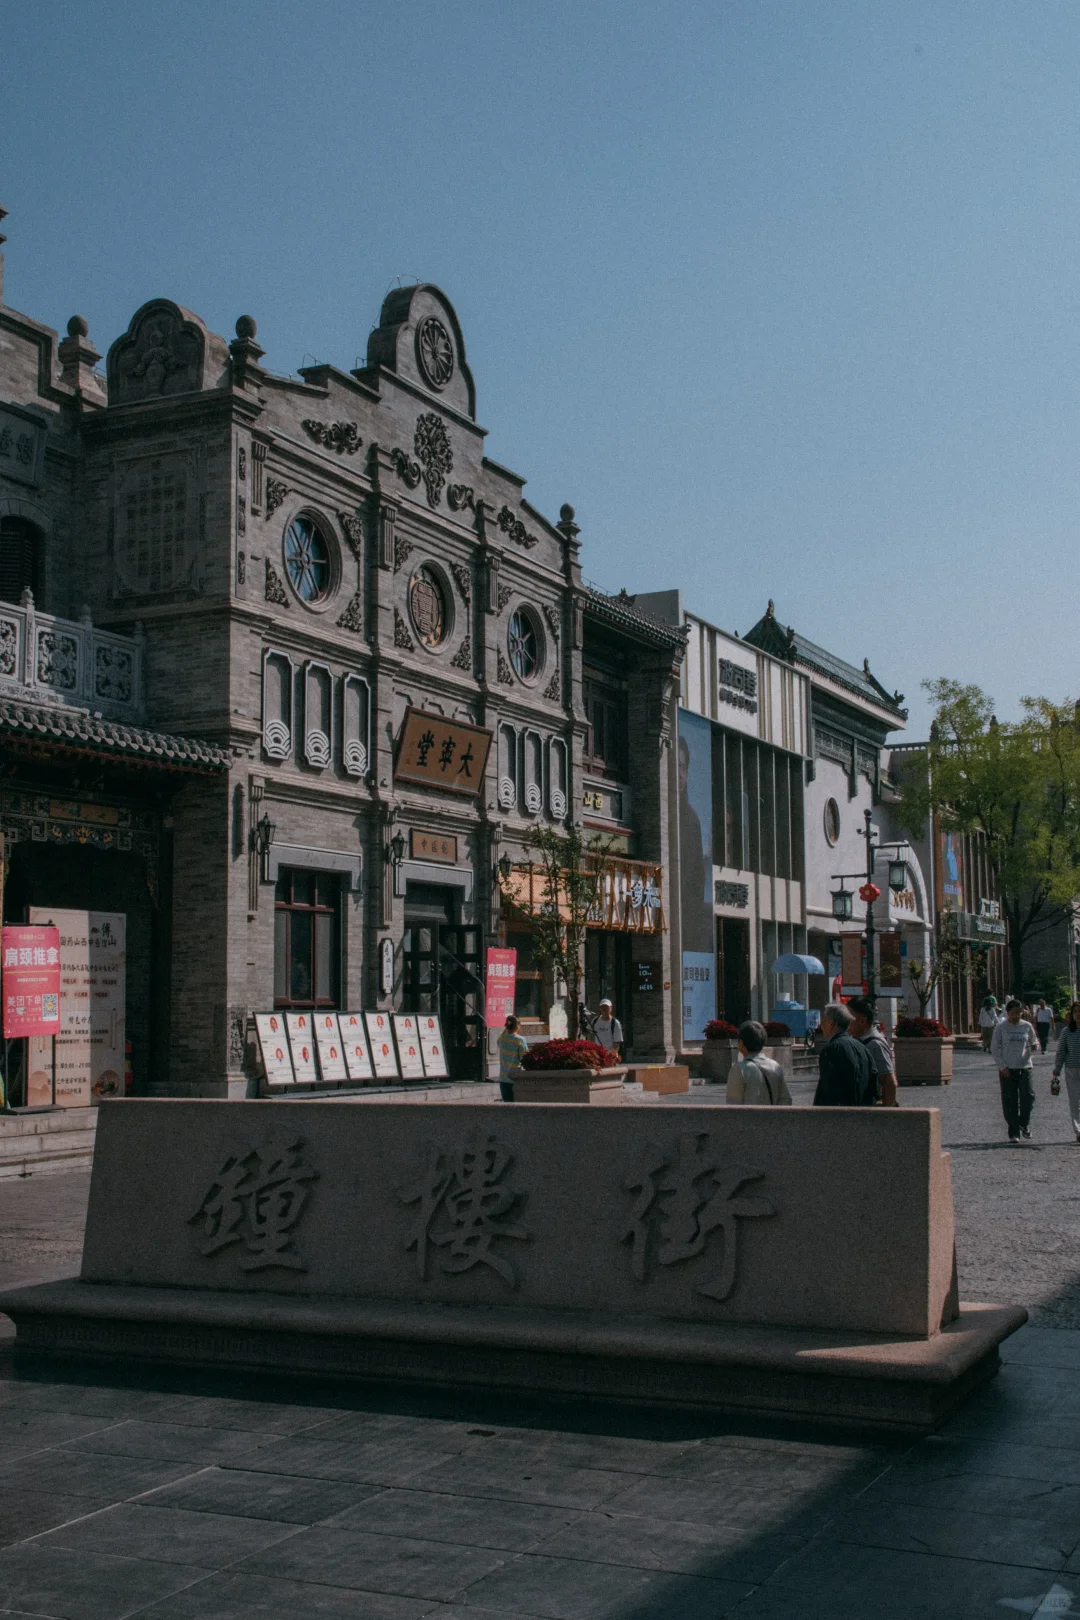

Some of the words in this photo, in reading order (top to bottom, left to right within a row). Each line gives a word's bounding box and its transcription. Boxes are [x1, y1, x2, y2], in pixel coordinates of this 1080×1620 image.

[719, 658, 757, 697] 波司登
[5, 946, 58, 967] 肩颈推拿
[188, 1132, 778, 1304] 鐘樓街
